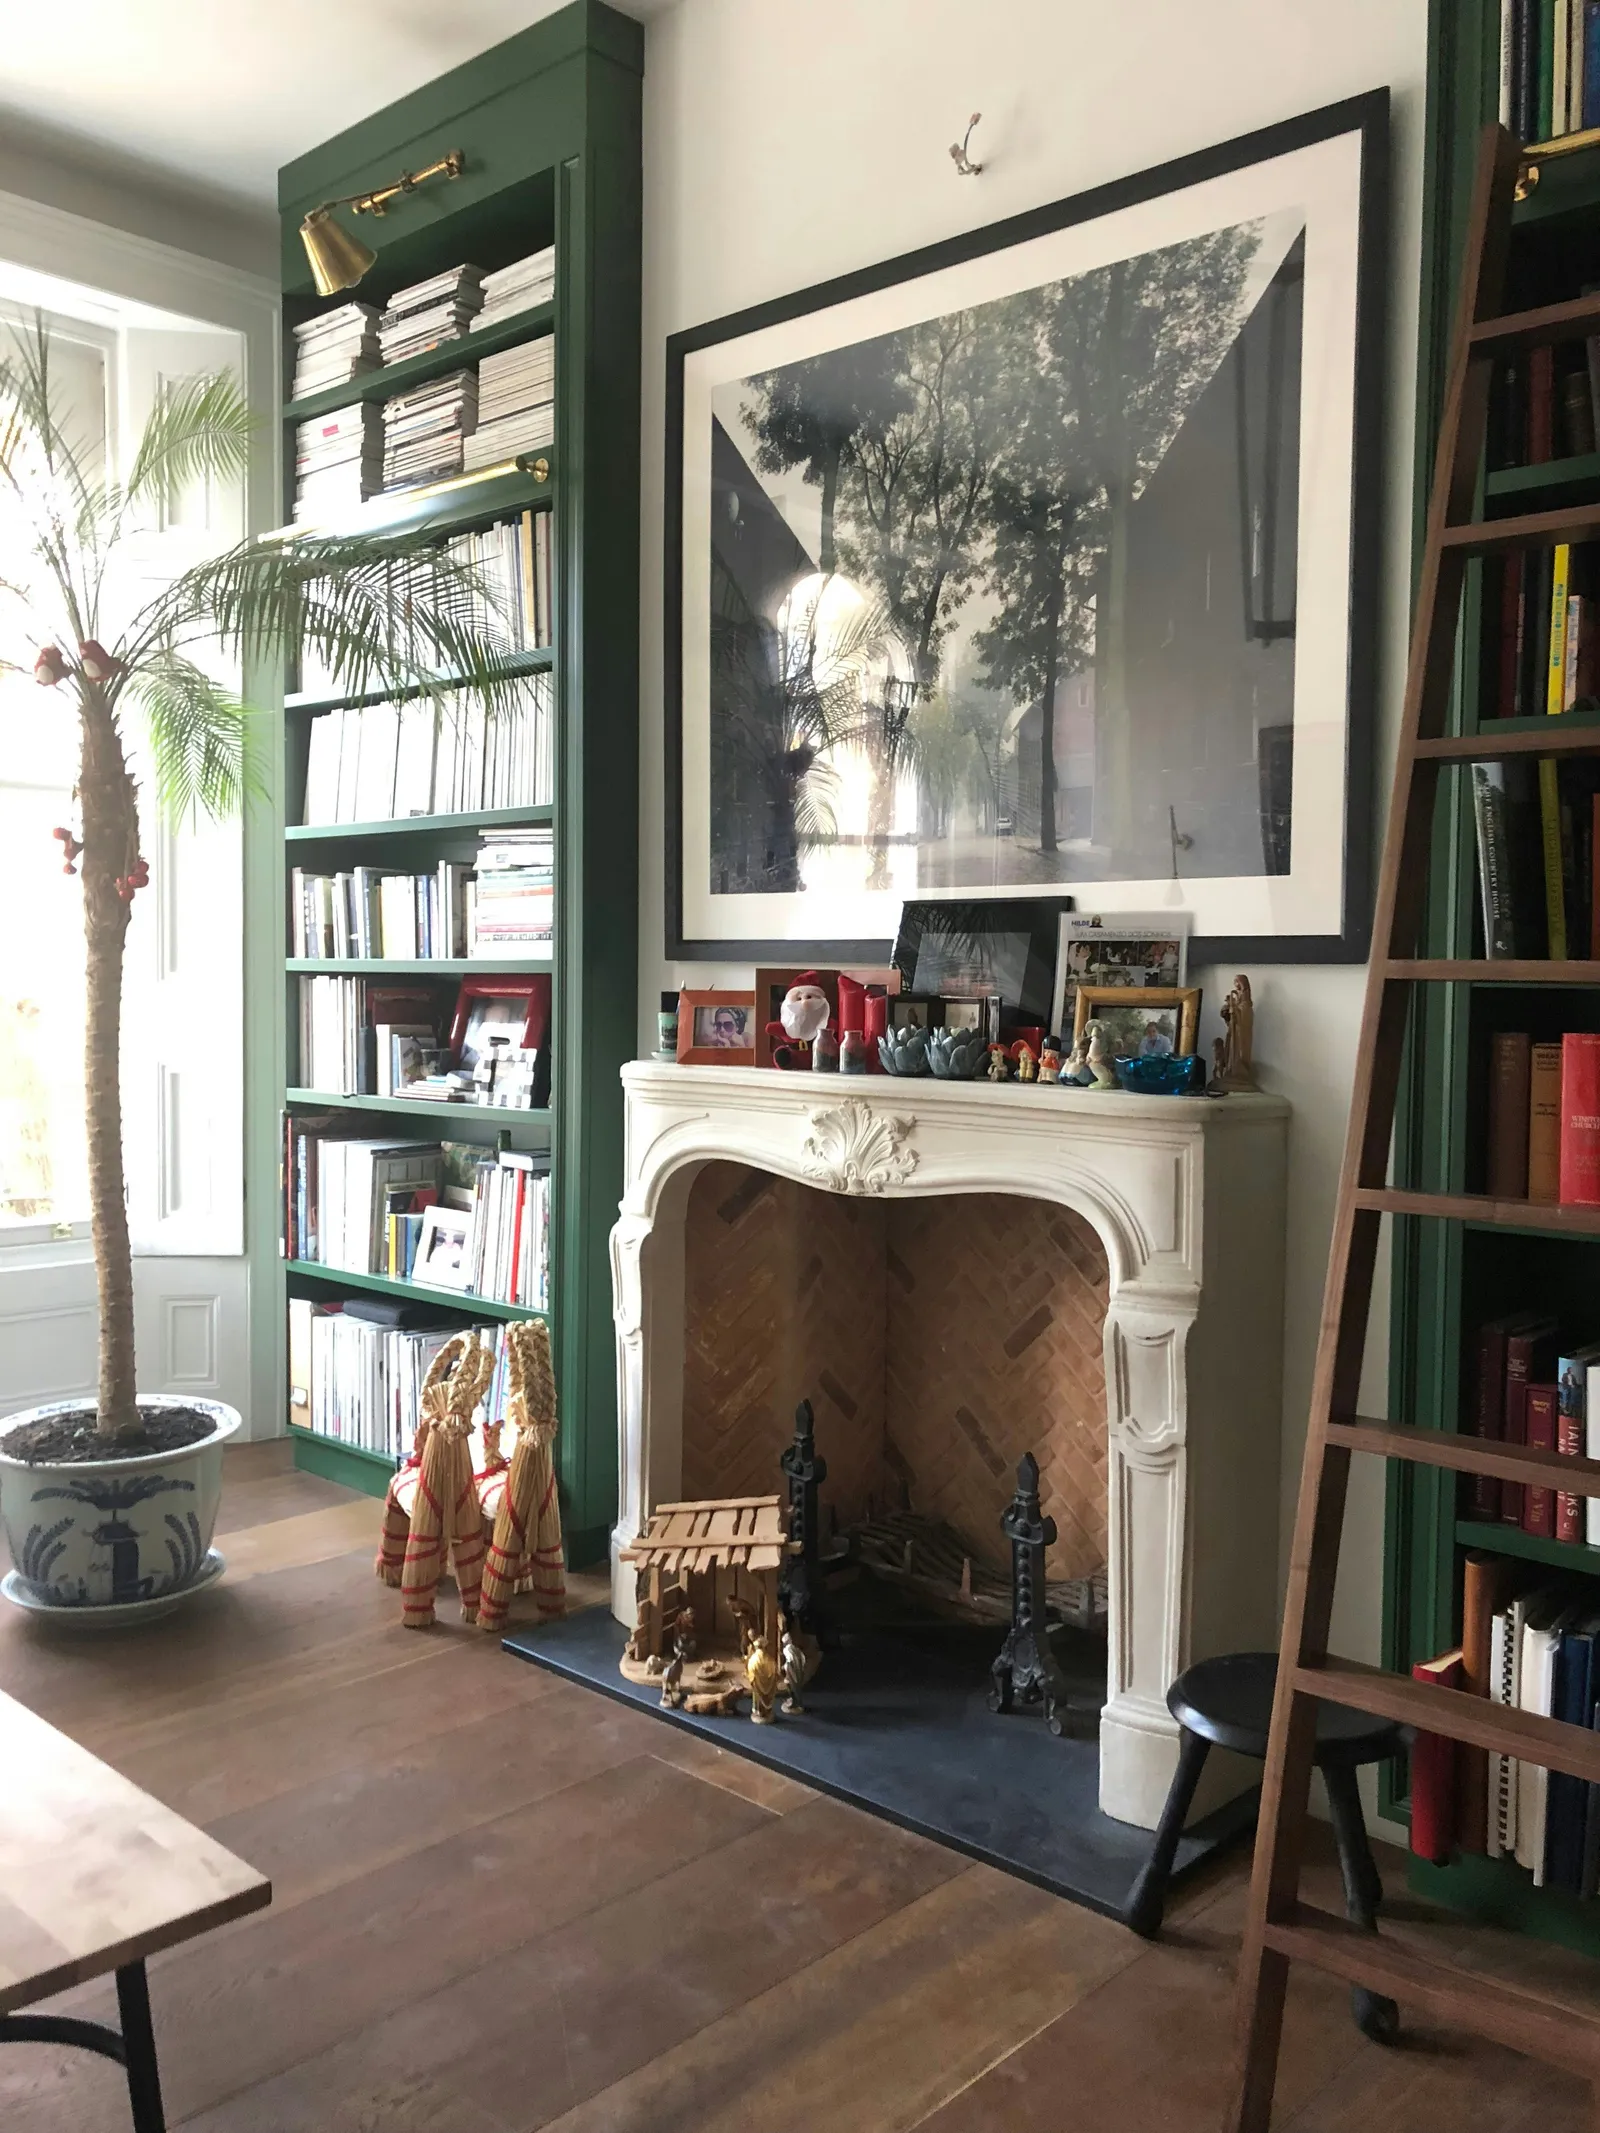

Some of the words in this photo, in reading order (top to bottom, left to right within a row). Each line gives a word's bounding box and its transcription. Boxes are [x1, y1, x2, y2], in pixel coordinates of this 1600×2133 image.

[1486, 805, 1494, 844] ENGLISH
[1488, 846, 1498, 888] COUNTRY
[1491, 890, 1500, 920] HOUSE
